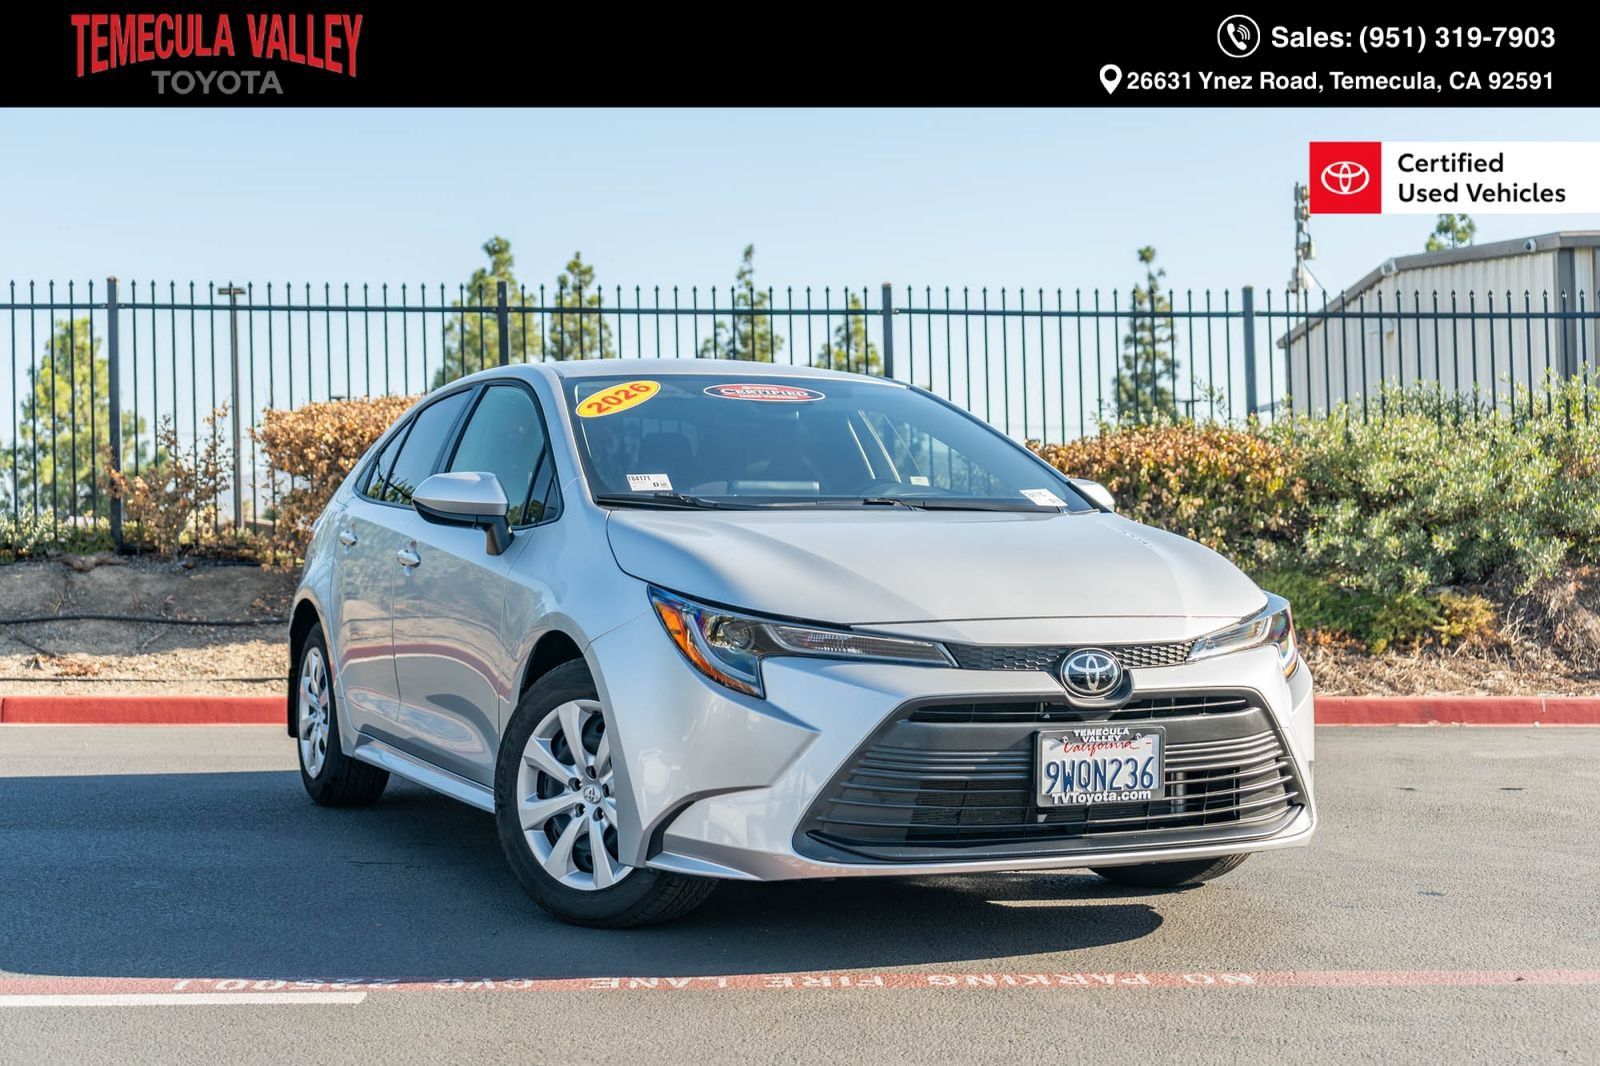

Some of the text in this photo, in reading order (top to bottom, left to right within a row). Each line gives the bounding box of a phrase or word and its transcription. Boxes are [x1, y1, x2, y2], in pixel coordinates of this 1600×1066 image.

[587, 383, 650, 413] 2026
[1074, 728, 1130, 737] TEMECULA
[1083, 735, 1122, 743] VALLEY
[1063, 740, 1140, 757] California
[1046, 757, 1155, 794] 9WQN236
[1052, 791, 1151, 805] TVToyota.com
[588, 977, 727, 989] LANE
[763, 976, 885, 988] FIRE
[927, 974, 1151, 986] PARKING
